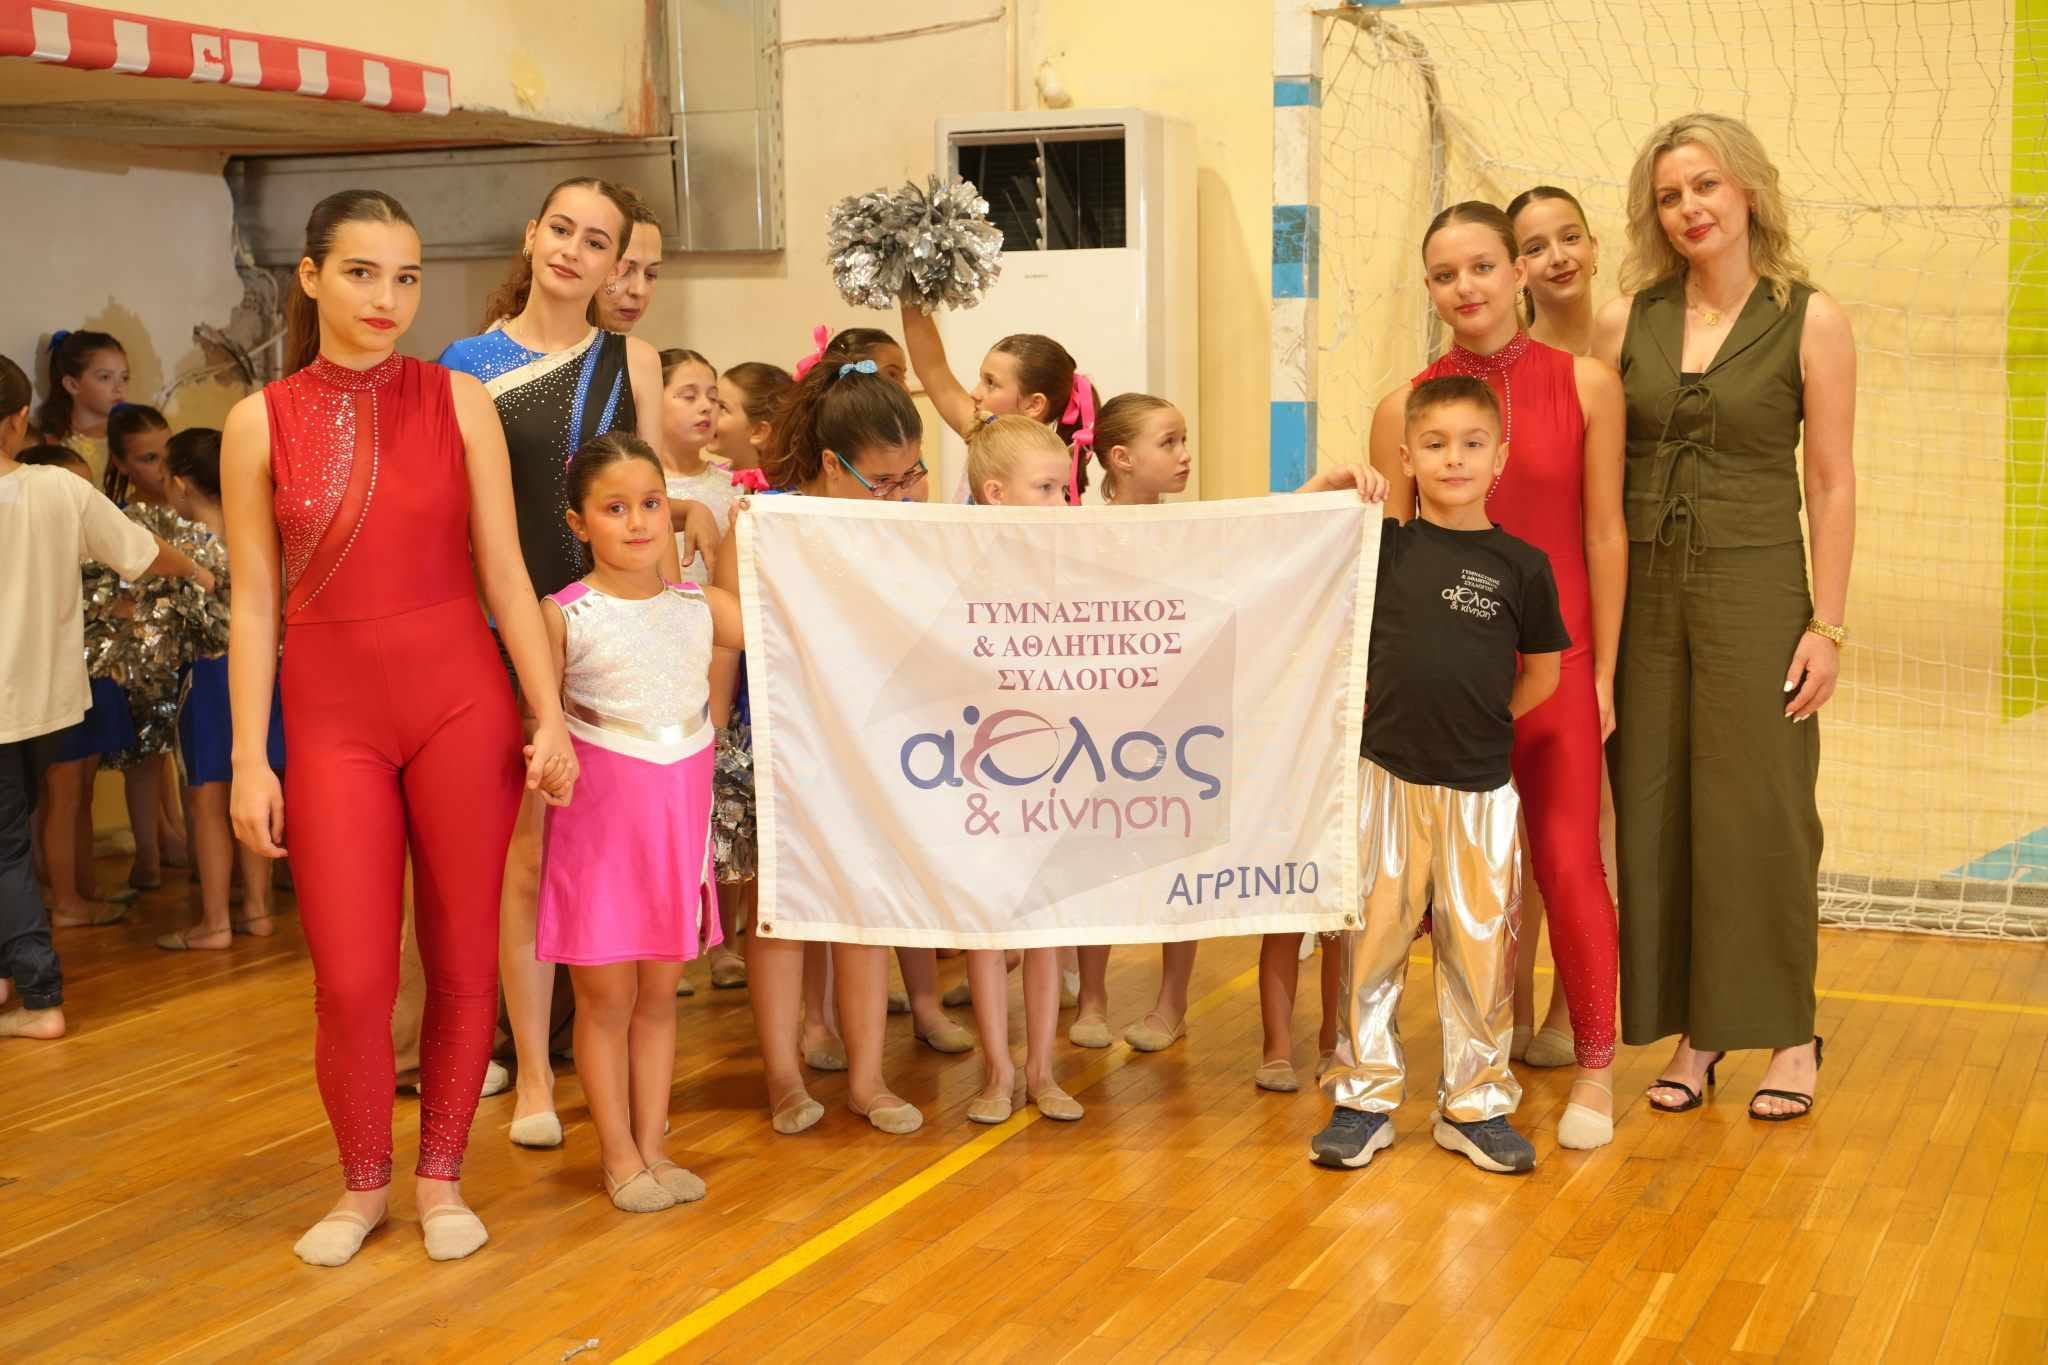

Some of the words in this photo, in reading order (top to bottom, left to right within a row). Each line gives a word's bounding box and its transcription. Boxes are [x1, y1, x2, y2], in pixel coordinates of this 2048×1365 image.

[966, 599, 1187, 625] ΓΥΜΝΑΣΤΙΚΟΣ
[972, 635, 994, 658] &
[1002, 632, 1183, 658] ΑΘΛΗΤΙΚΟΣ
[997, 666, 1160, 692] ΣΥΛΛΟΓΟΣ
[964, 792, 1001, 836] &
[1021, 788, 1192, 839] κίνηση
[1165, 861, 1319, 906] ΑΓΡΙΝΙΟ
